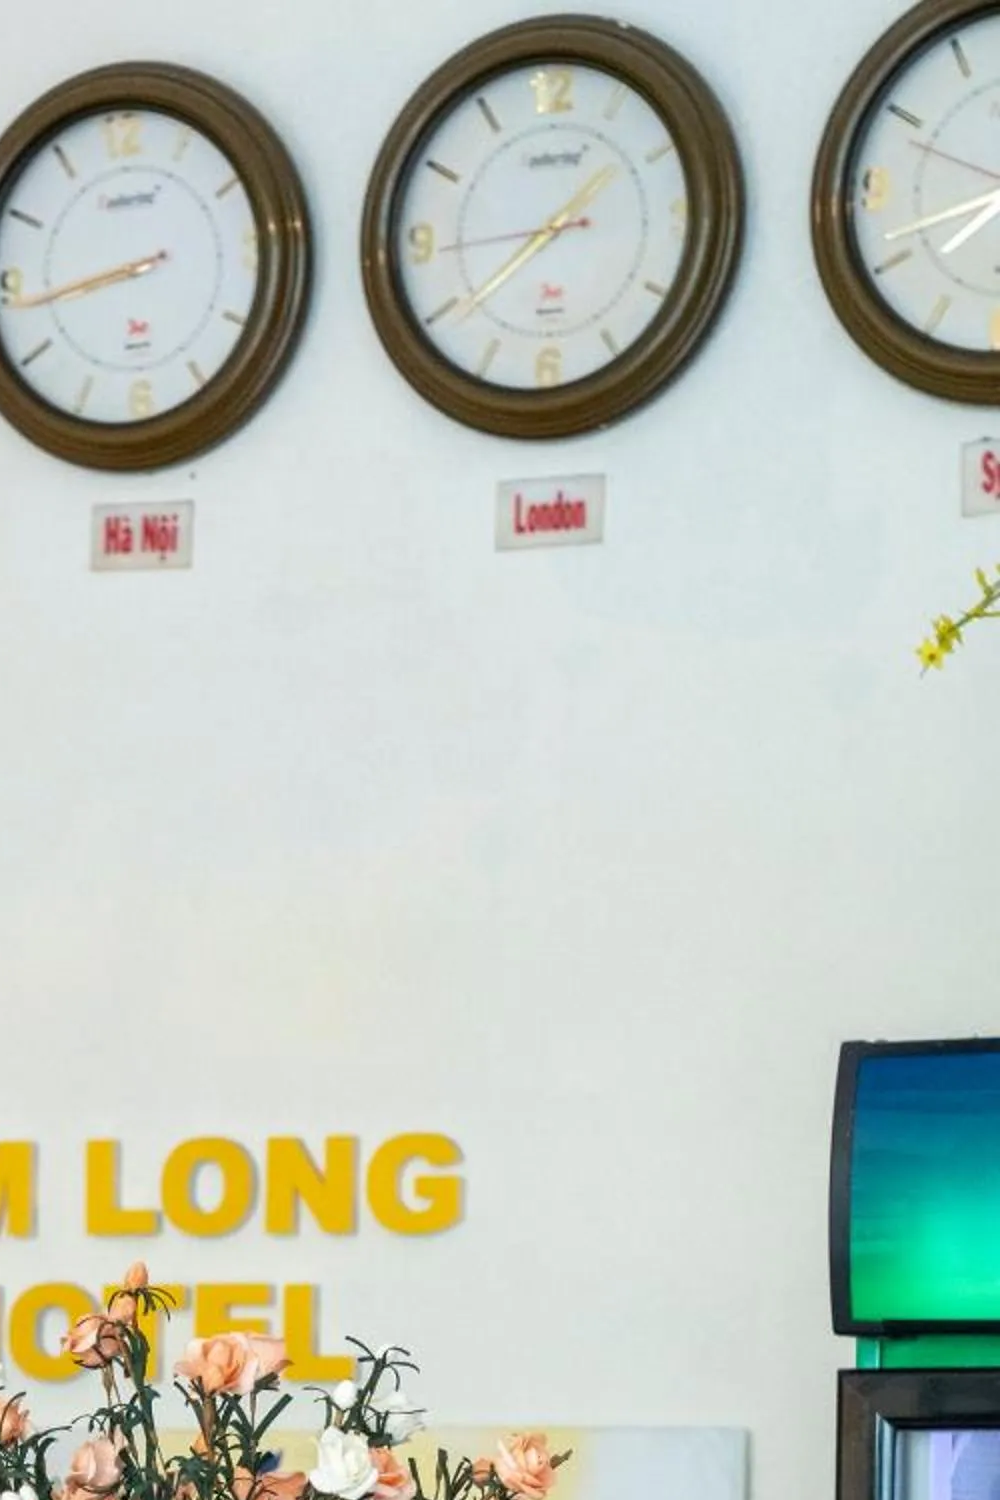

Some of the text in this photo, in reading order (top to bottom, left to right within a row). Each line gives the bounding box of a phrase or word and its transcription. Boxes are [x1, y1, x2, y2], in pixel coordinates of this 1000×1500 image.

[529, 69, 574, 113] 12
[410, 223, 434, 264] 9
[535, 345, 562, 385] 6
[128, 379, 153, 415] 6
[513, 491, 587, 535] London
[103, 513, 178, 559] Hà Nội
[86, 1133, 462, 1237] LONG
